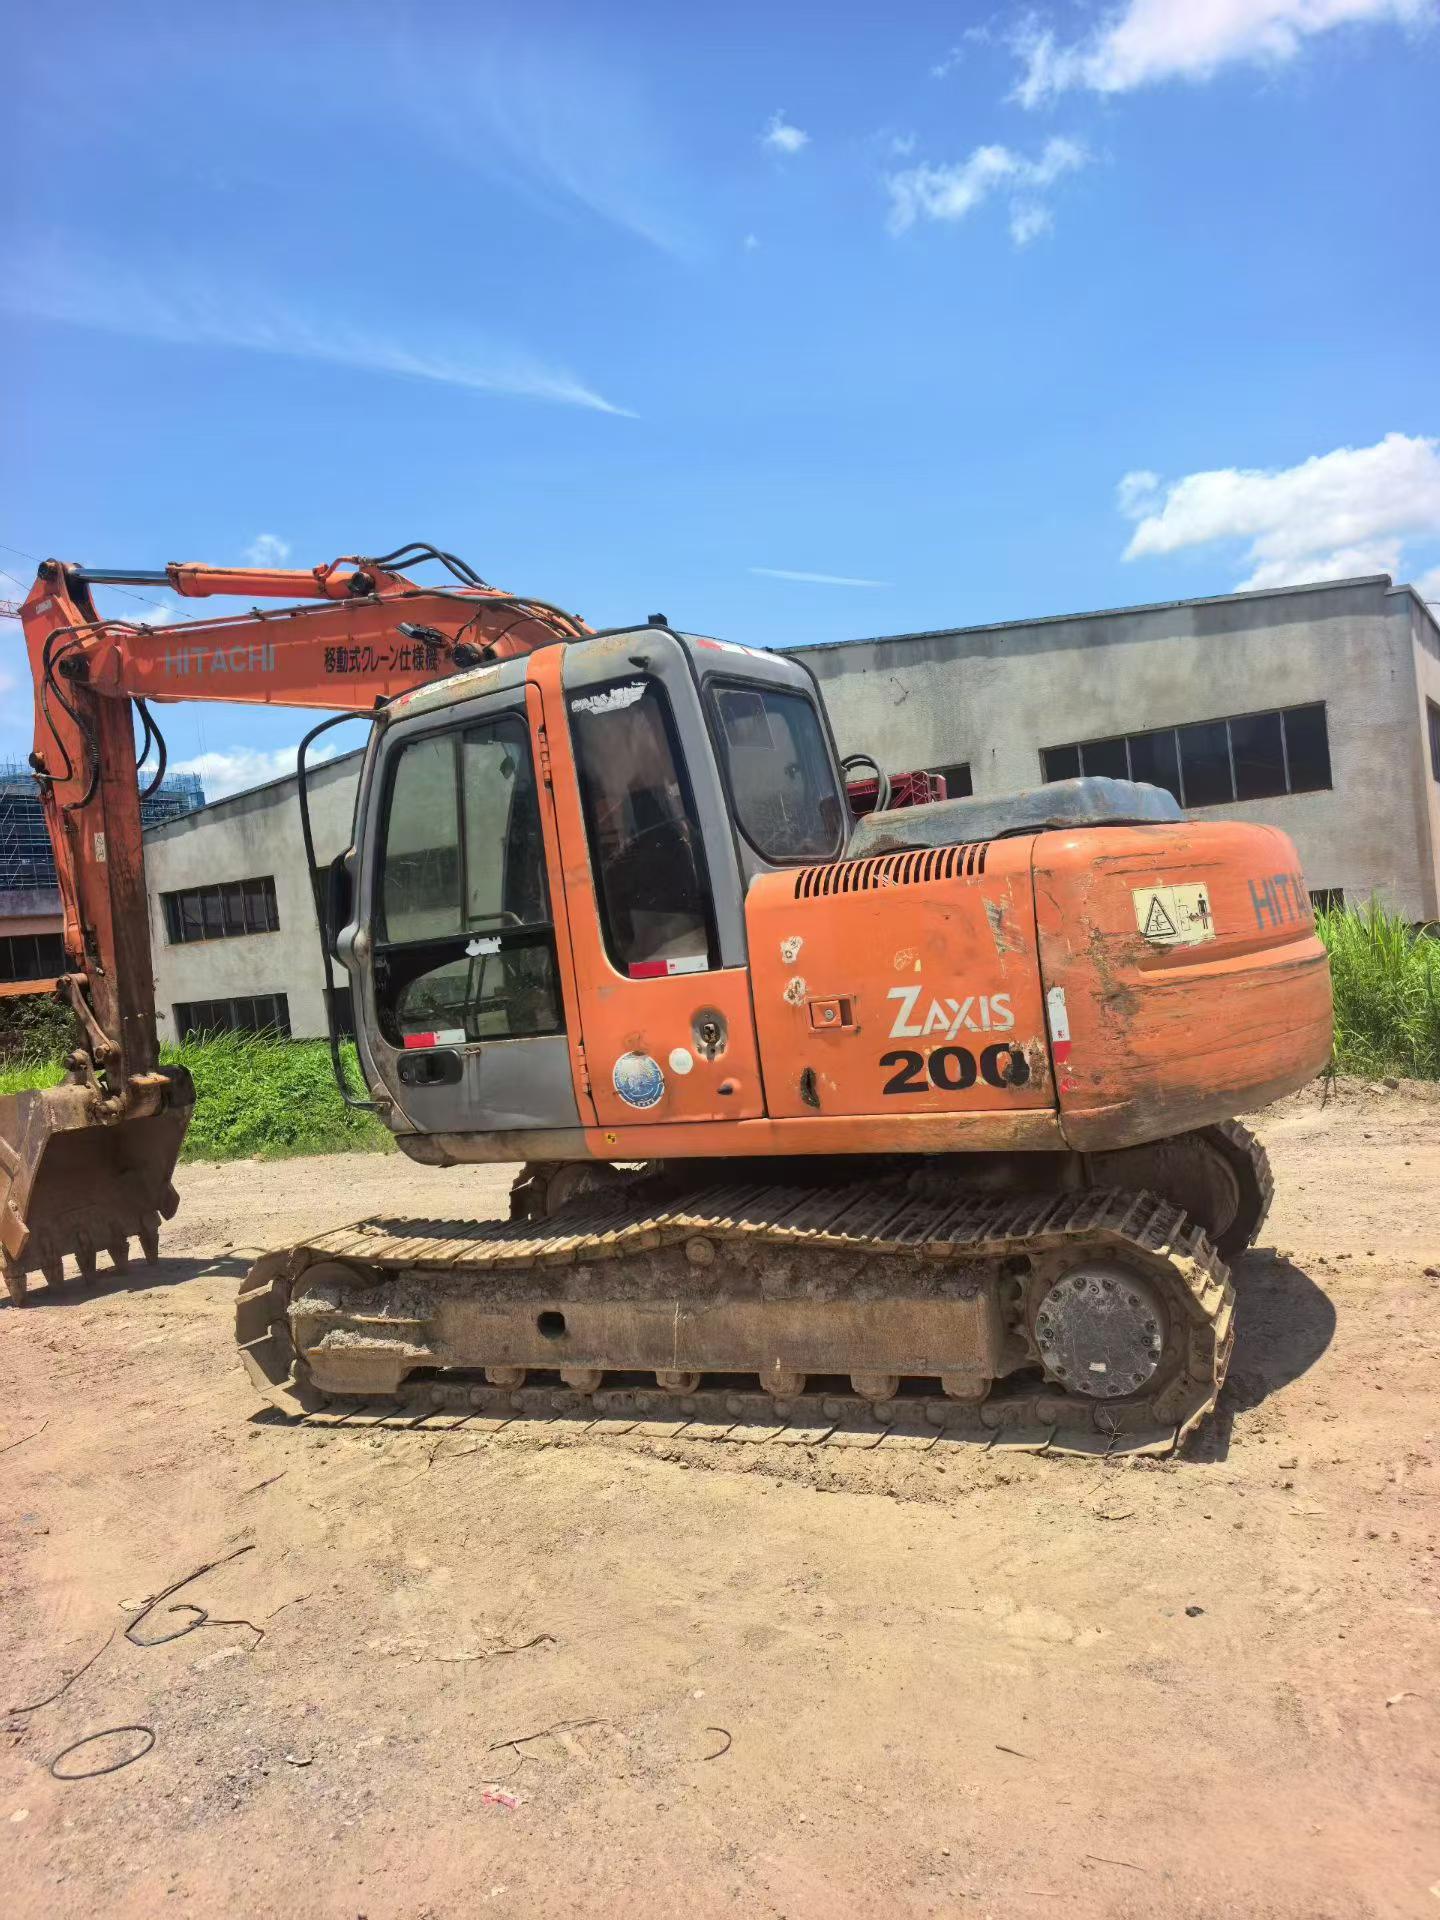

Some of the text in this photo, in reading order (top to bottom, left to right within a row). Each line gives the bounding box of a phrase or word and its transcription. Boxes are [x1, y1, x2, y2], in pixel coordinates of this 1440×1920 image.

[164, 643, 276, 674] HITACHI
[886, 985, 1015, 1041] ZAXIS
[879, 1042, 1030, 1095] 200
